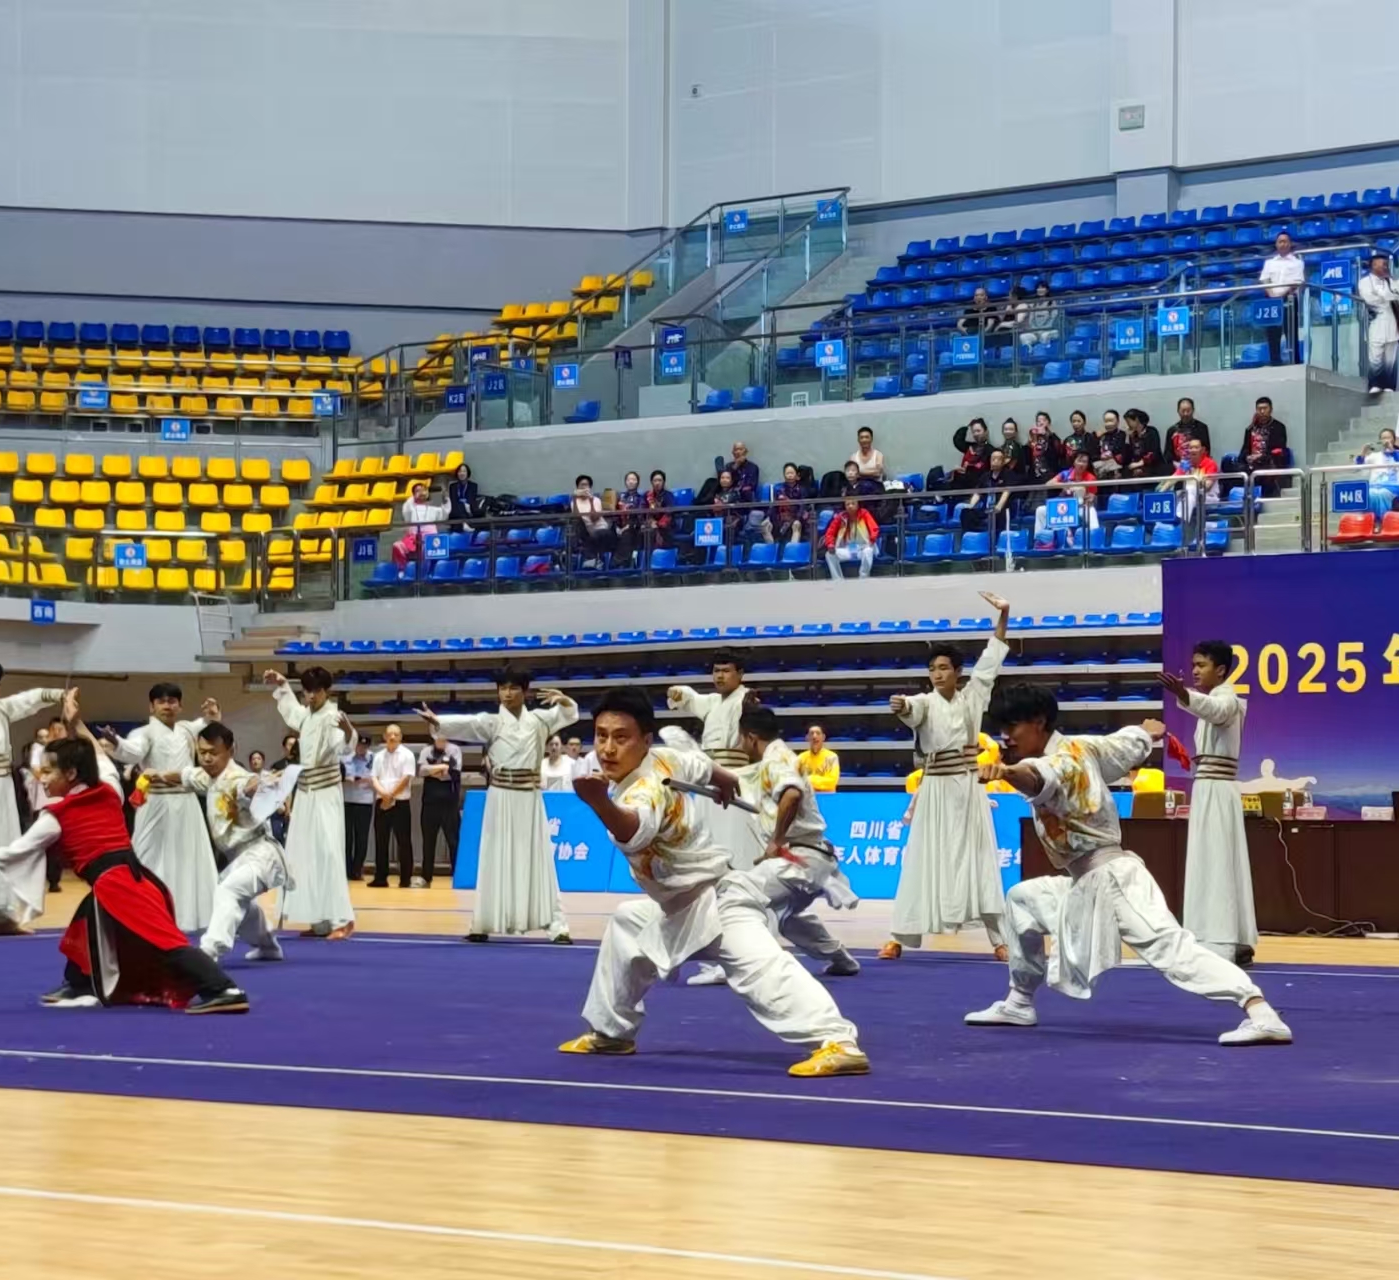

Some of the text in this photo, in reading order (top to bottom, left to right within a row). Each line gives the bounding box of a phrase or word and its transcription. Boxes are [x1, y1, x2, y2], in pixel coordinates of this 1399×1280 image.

[1255, 306, 1279, 319] J2区
[1339, 489, 1364, 503] H4区
[1149, 500, 1171, 514] J3区
[850, 820, 904, 841] 四川省
[834, 845, 906, 867] 年人体育
